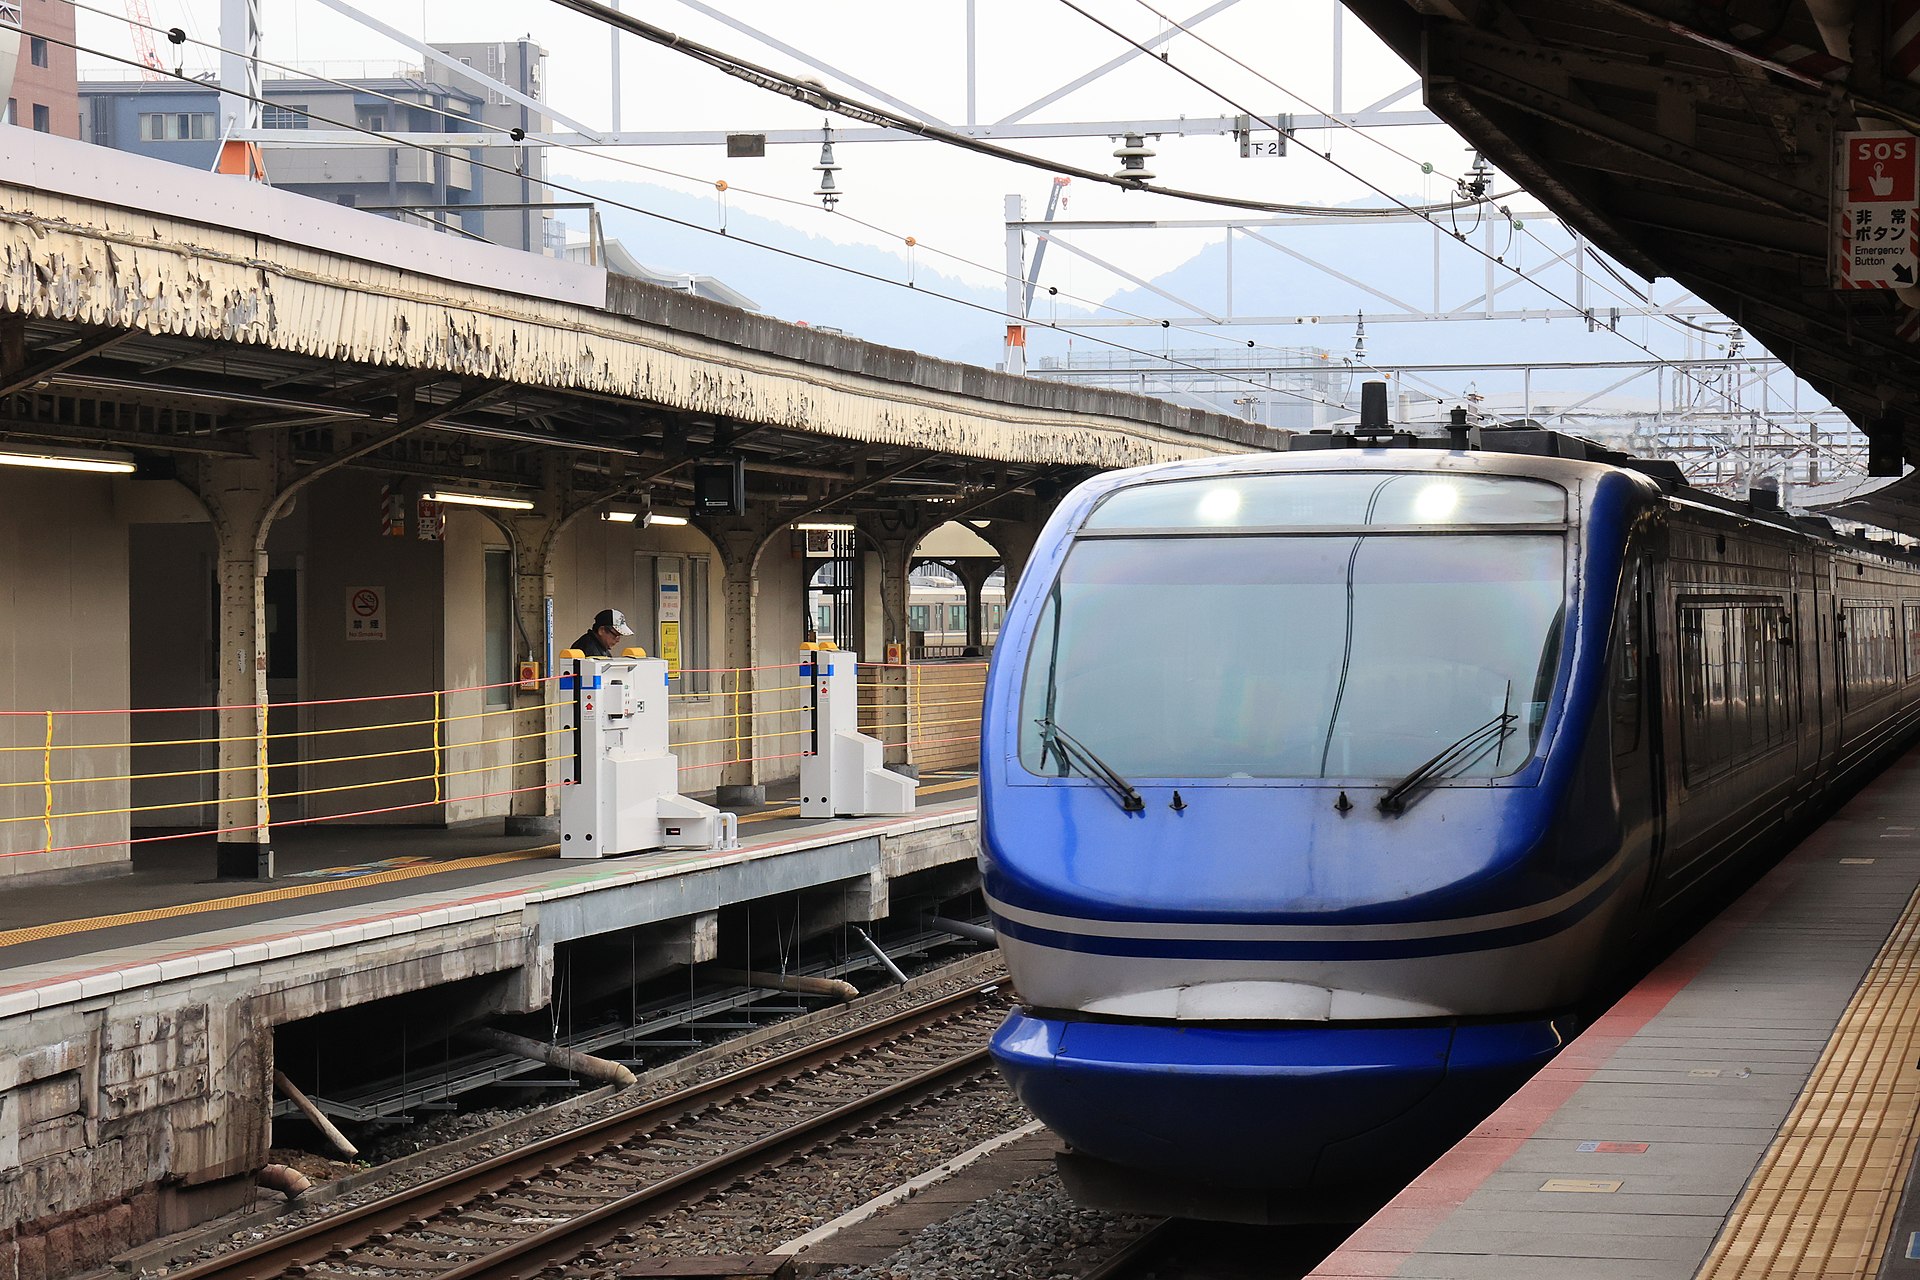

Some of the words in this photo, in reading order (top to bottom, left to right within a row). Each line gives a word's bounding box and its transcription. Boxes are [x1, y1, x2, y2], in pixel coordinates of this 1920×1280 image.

[1251, 142, 1277, 156] 下2
[1858, 142, 1907, 161] SOS
[1856, 226, 1905, 241] ボタン
[1855, 245, 1905, 255] Emergency
[1855, 257, 1885, 266] Button
